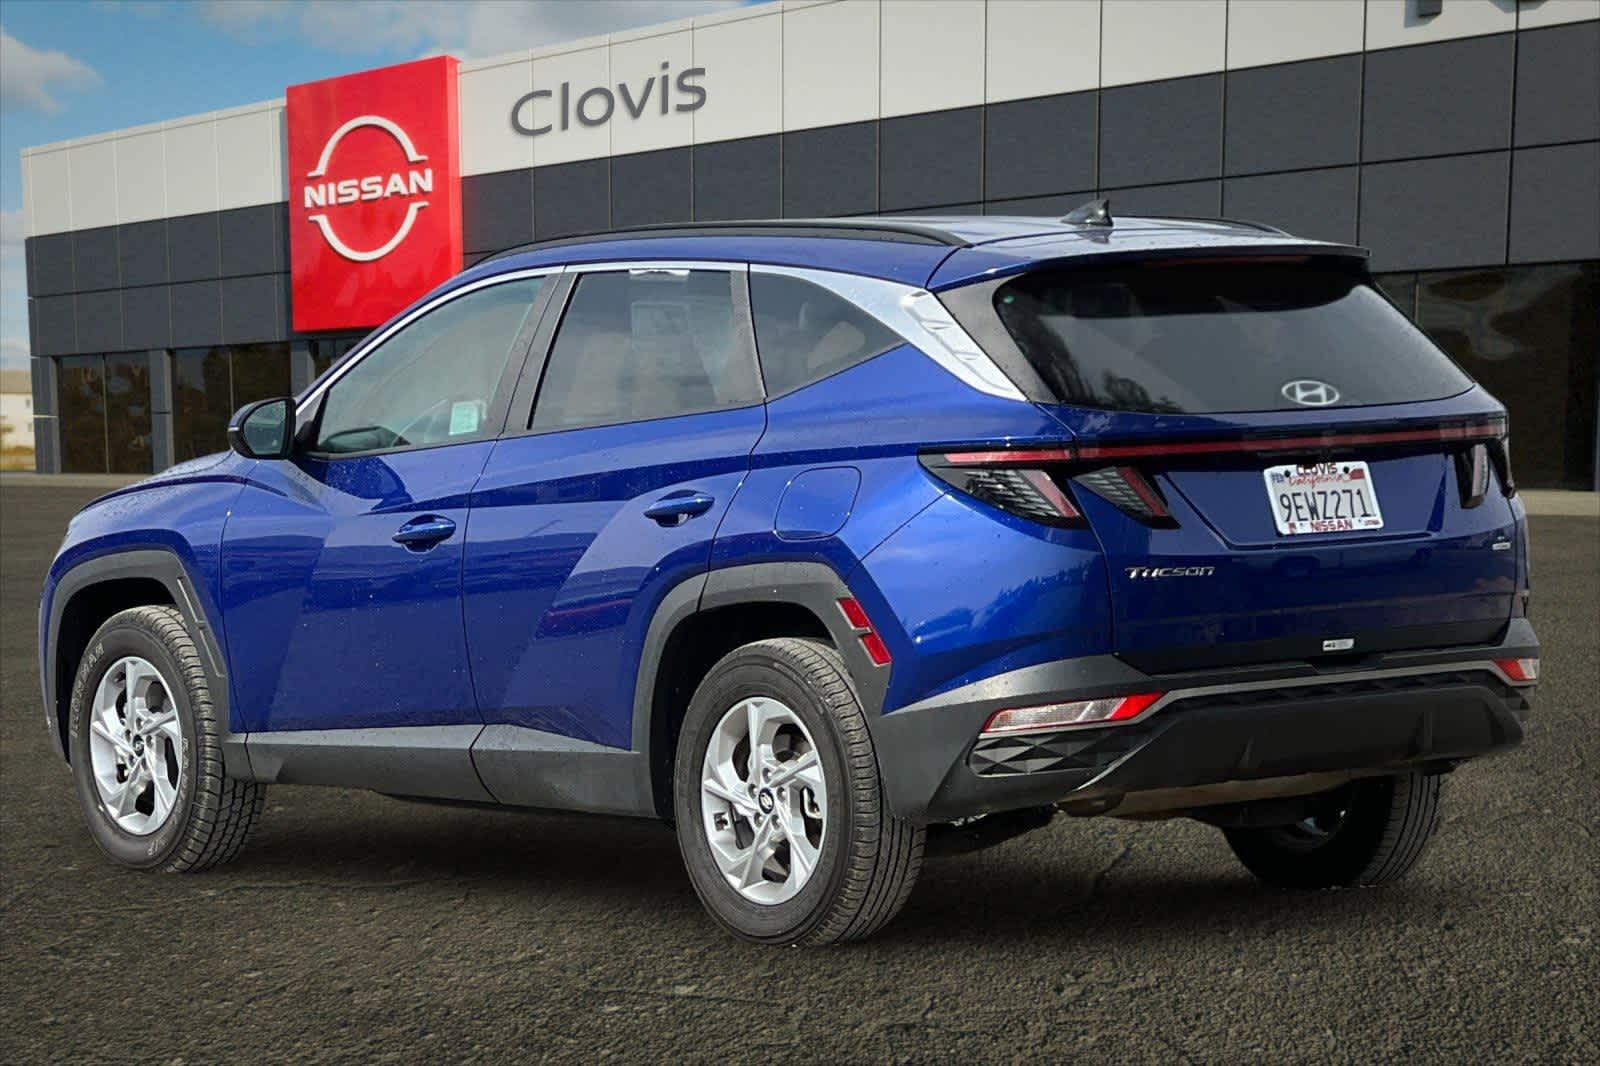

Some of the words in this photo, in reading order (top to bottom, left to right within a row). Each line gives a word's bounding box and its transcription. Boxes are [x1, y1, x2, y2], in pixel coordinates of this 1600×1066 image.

[511, 61, 707, 137] Clovis
[303, 168, 433, 210] NISSAN
[1280, 489, 1373, 521] 9EWZ271
[1310, 520, 1353, 532] NISSAN
